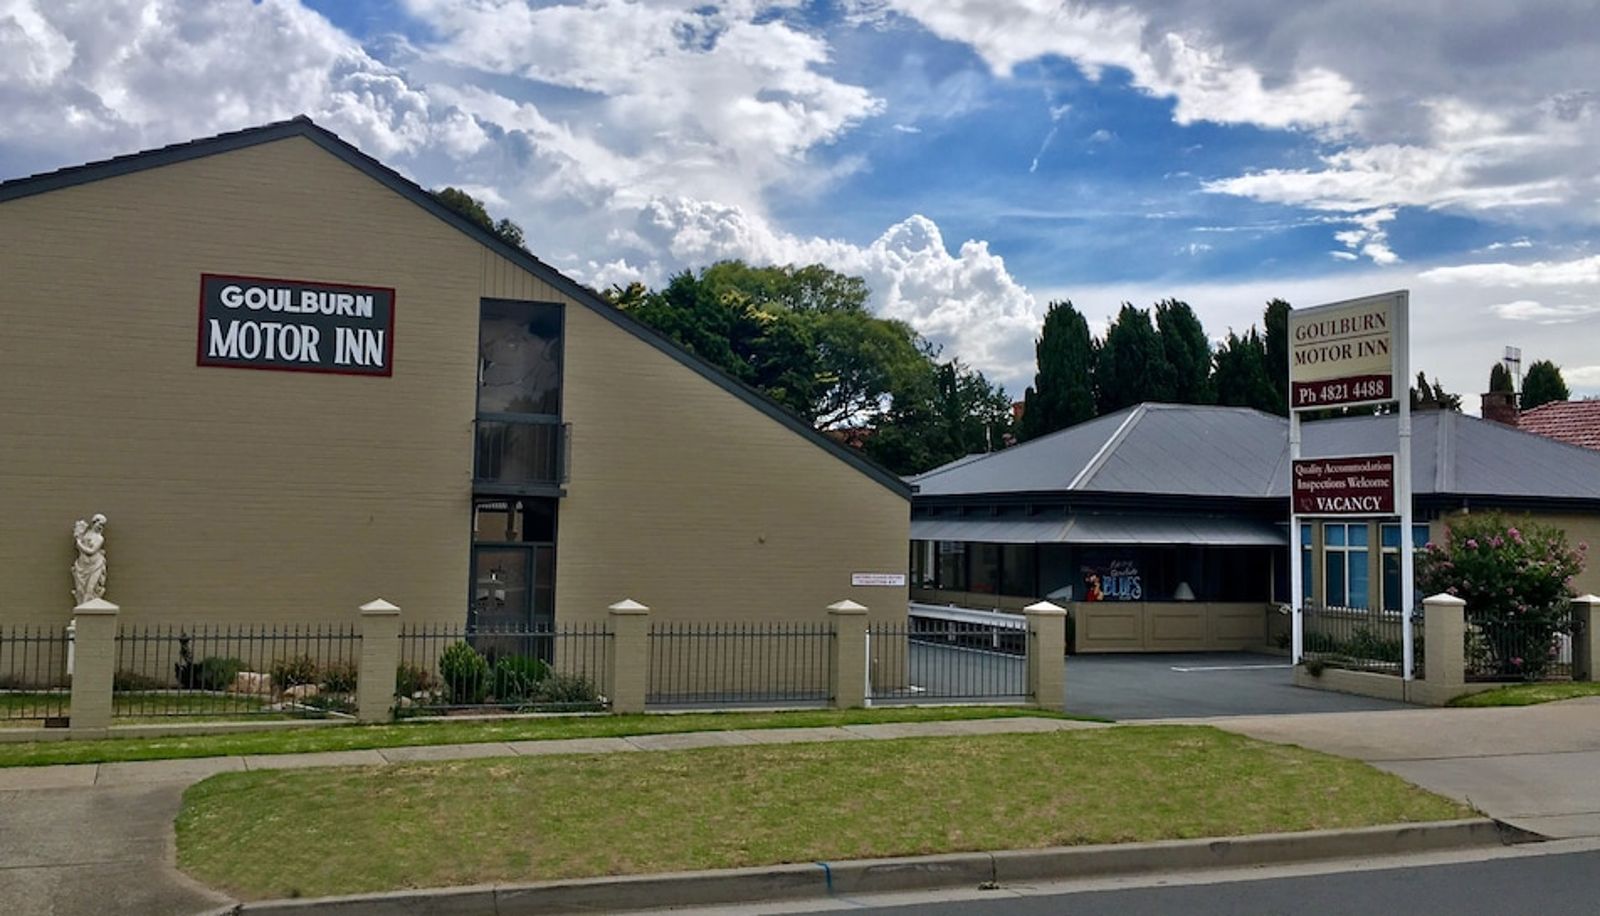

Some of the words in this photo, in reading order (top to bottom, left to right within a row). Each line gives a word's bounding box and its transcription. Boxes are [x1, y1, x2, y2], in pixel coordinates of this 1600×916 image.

[220, 285, 374, 318] GOULBURN
[1295, 311, 1387, 341] GOULBURN
[208, 318, 321, 363] MOTOR
[334, 326, 385, 367] INN
[1295, 343, 1353, 366] MOTOR
[1358, 337, 1390, 358] INN
[1299, 388, 1317, 404] Ph
[1320, 383, 1348, 401] 4821
[1353, 379, 1384, 398] 4488
[1295, 463, 1323, 477] Quality
[1324, 460, 1392, 473] Accommodation
[1297, 477, 1346, 493] Inspections
[1347, 475, 1390, 489] Welcome
[1316, 496, 1382, 511] VACANCY
[1102, 574, 1142, 600] BLUES
